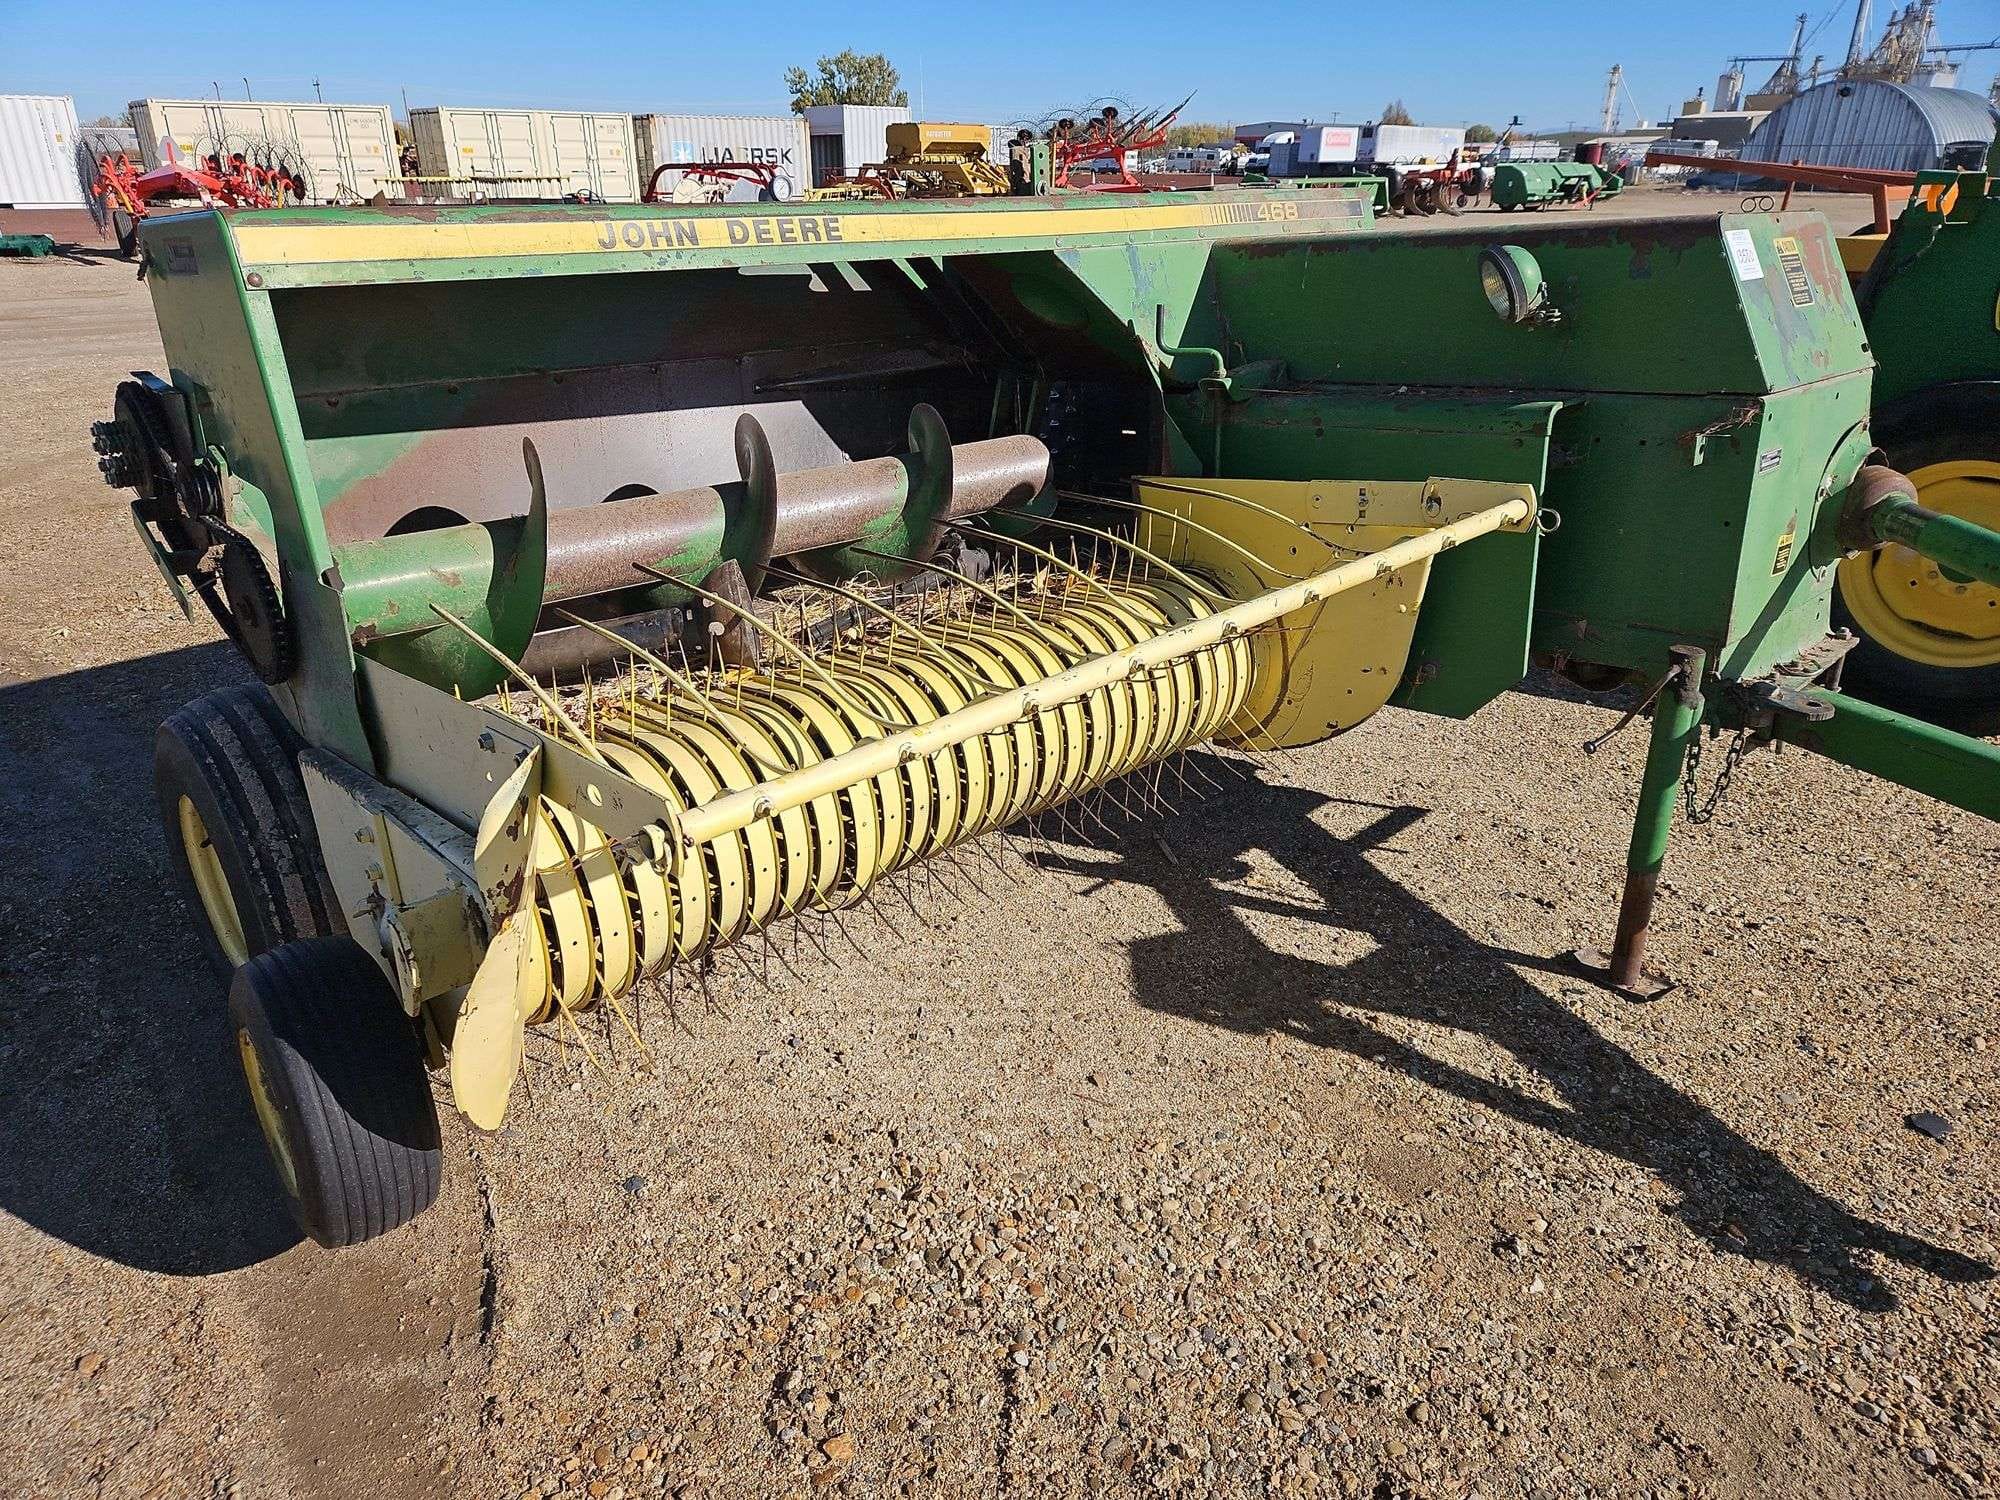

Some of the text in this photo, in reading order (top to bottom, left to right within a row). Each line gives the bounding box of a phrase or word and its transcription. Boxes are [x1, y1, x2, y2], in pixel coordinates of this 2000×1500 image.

[702, 147, 792, 165] MARSK
[1257, 201, 1299, 221] 468
[597, 216, 843, 249] JOHN DEERE
